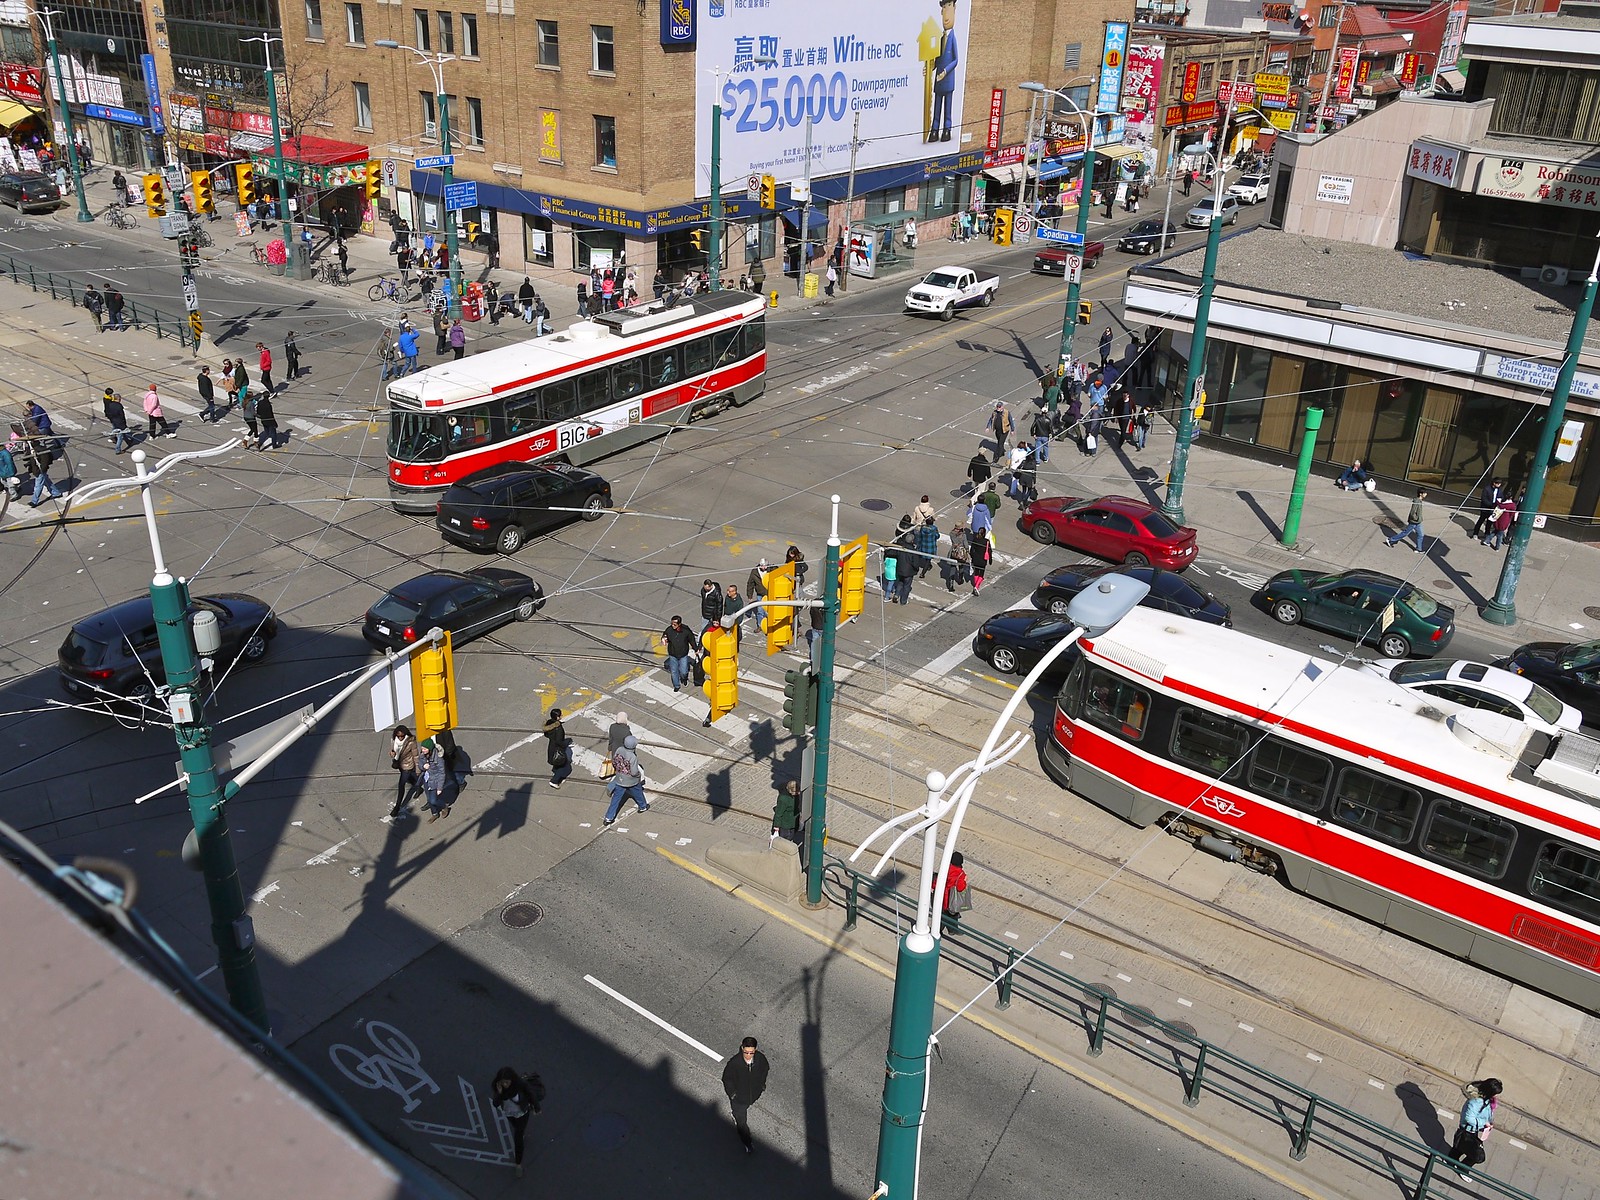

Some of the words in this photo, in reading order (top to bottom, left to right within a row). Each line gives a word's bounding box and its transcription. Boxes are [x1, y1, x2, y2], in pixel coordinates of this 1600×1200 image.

[735, 0, 747, 9] RBC
[710, 8, 723, 16] RBC
[673, 26, 690, 36] RBC
[782, 47, 828, 67] 置业首期
[833, 34, 865, 64] Win
[867, 45, 882, 60] the
[884, 43, 902, 58] RBC
[852, 75, 908, 93] Downpayment
[722, 71, 848, 133] $25,000
[419, 158, 440, 167] Dundas
[444, 155, 450, 164] W
[750, 162, 765, 170] Buying
[765, 160, 774, 168] your
[775, 158, 784, 166] first
[1504, 160, 1522, 168] RIC
[1537, 165, 1600, 186] Robinson
[1482, 187, 1525, 199] 416-597-6699
[552, 198, 564, 206] RBC
[552, 206, 578, 217] Financial
[579, 211, 597, 222] Group
[658, 210, 671, 218] RBC
[173, 221, 188, 229] SIGNAL
[658, 216, 684, 227] Financial
[684, 214, 701, 223] Group
[1042, 229, 1069, 241] Spadina
[1500, 356, 1532, 369] Dundas
[1496, 369, 1525, 381] Sports
[560, 426, 585, 450] BIG
